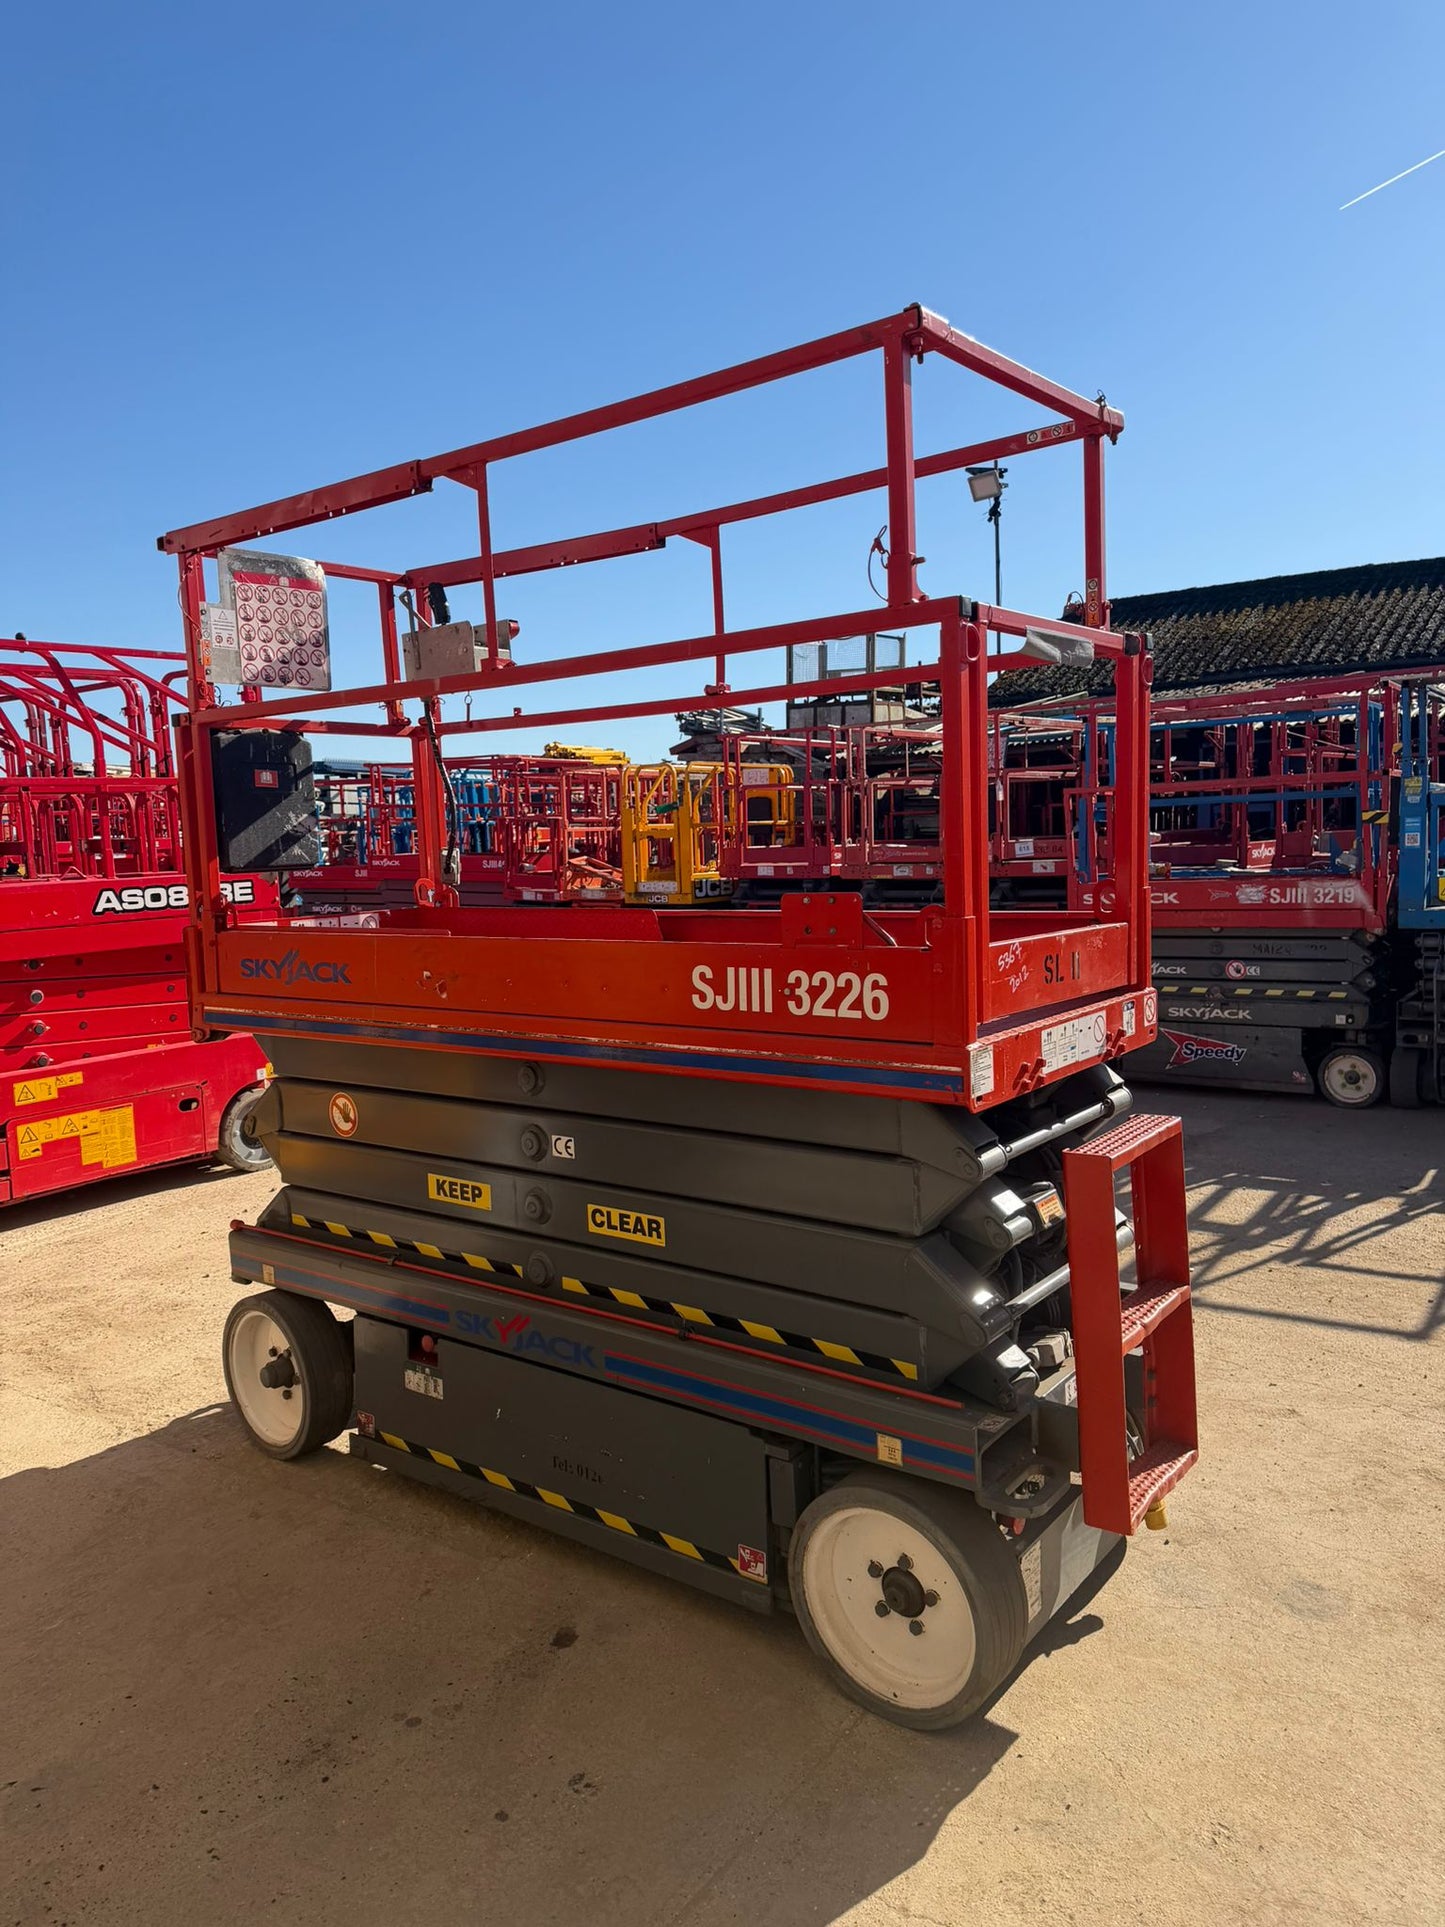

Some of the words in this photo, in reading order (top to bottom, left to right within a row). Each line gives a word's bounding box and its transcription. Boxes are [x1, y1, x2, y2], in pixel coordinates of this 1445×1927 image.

[372, 858, 400, 867] SKYJACK
[293, 868, 323, 878] SKYJACK
[694, 878, 733, 898] JCB
[1269, 887, 1307, 904] SJIII
[1313, 887, 1355, 904] 3219
[649, 894, 668, 903] JCB
[312, 904, 343, 914] SKYJACK
[240, 949, 352, 986] SKYJACK
[1044, 953, 1065, 985] SL
[691, 964, 773, 1013] SJIII
[787, 969, 890, 1021] 3226
[1167, 1002, 1252, 1020] SKYJACK
[1182, 1042, 1248, 1062] Speedy
[553, 1137, 574, 1156] CE
[435, 1178, 483, 1203] KEEP
[590, 1208, 662, 1240] CLEAR
[455, 1309, 598, 1369] SKYJACK
